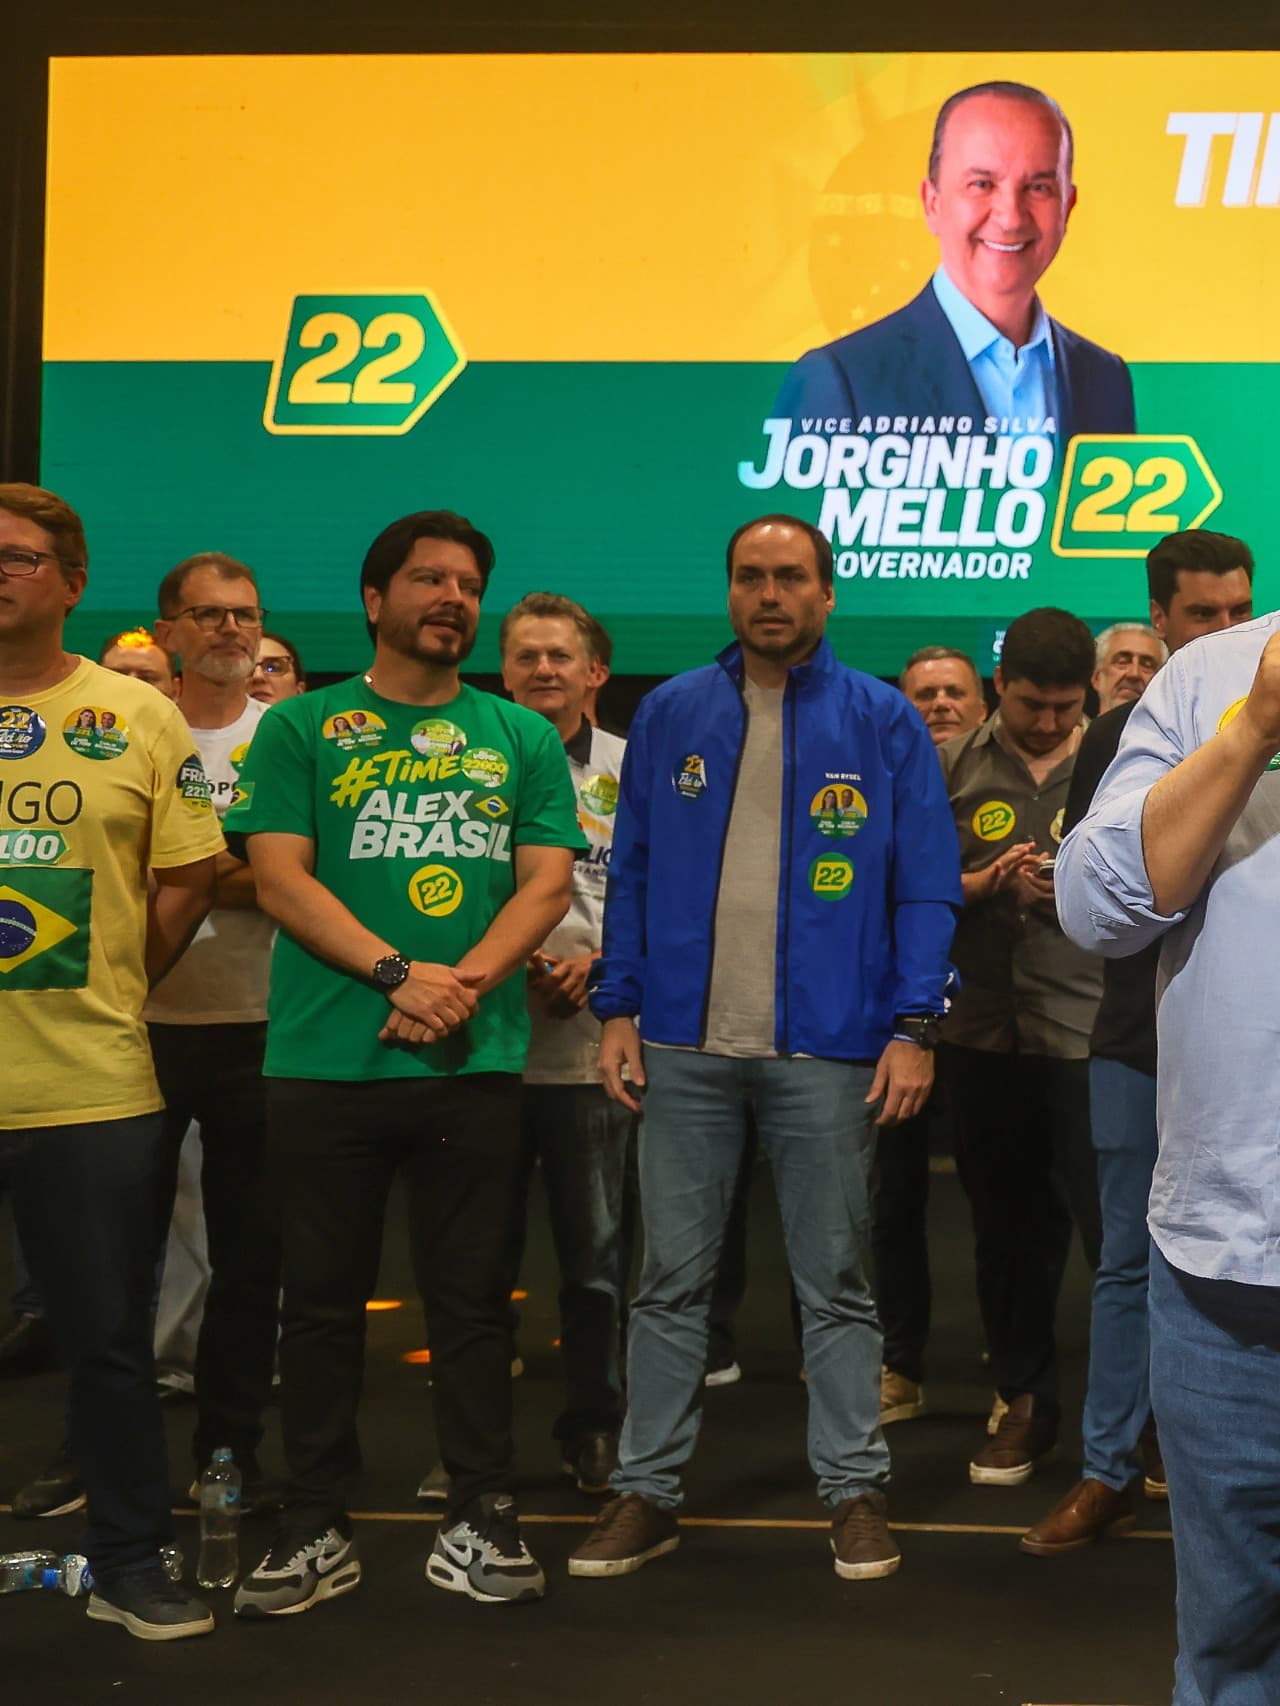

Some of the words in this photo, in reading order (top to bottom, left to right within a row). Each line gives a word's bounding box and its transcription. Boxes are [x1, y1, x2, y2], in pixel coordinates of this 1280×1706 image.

[288, 312, 427, 405] 22
[801, 417, 852, 434] VICE
[857, 416, 974, 434] ADRIANO
[984, 417, 1058, 434] SILVA
[737, 418, 1054, 490] JORGINHO
[1071, 456, 1189, 533] 22
[817, 487, 1047, 549] MELLO
[833, 550, 1033, 580] OVERNADOR
[357, 788, 475, 824] ALEX
[981, 809, 1007, 834] 22
[349, 820, 512, 862] BRASIL
[420, 876, 453, 905] 22
[817, 866, 847, 887] 22
